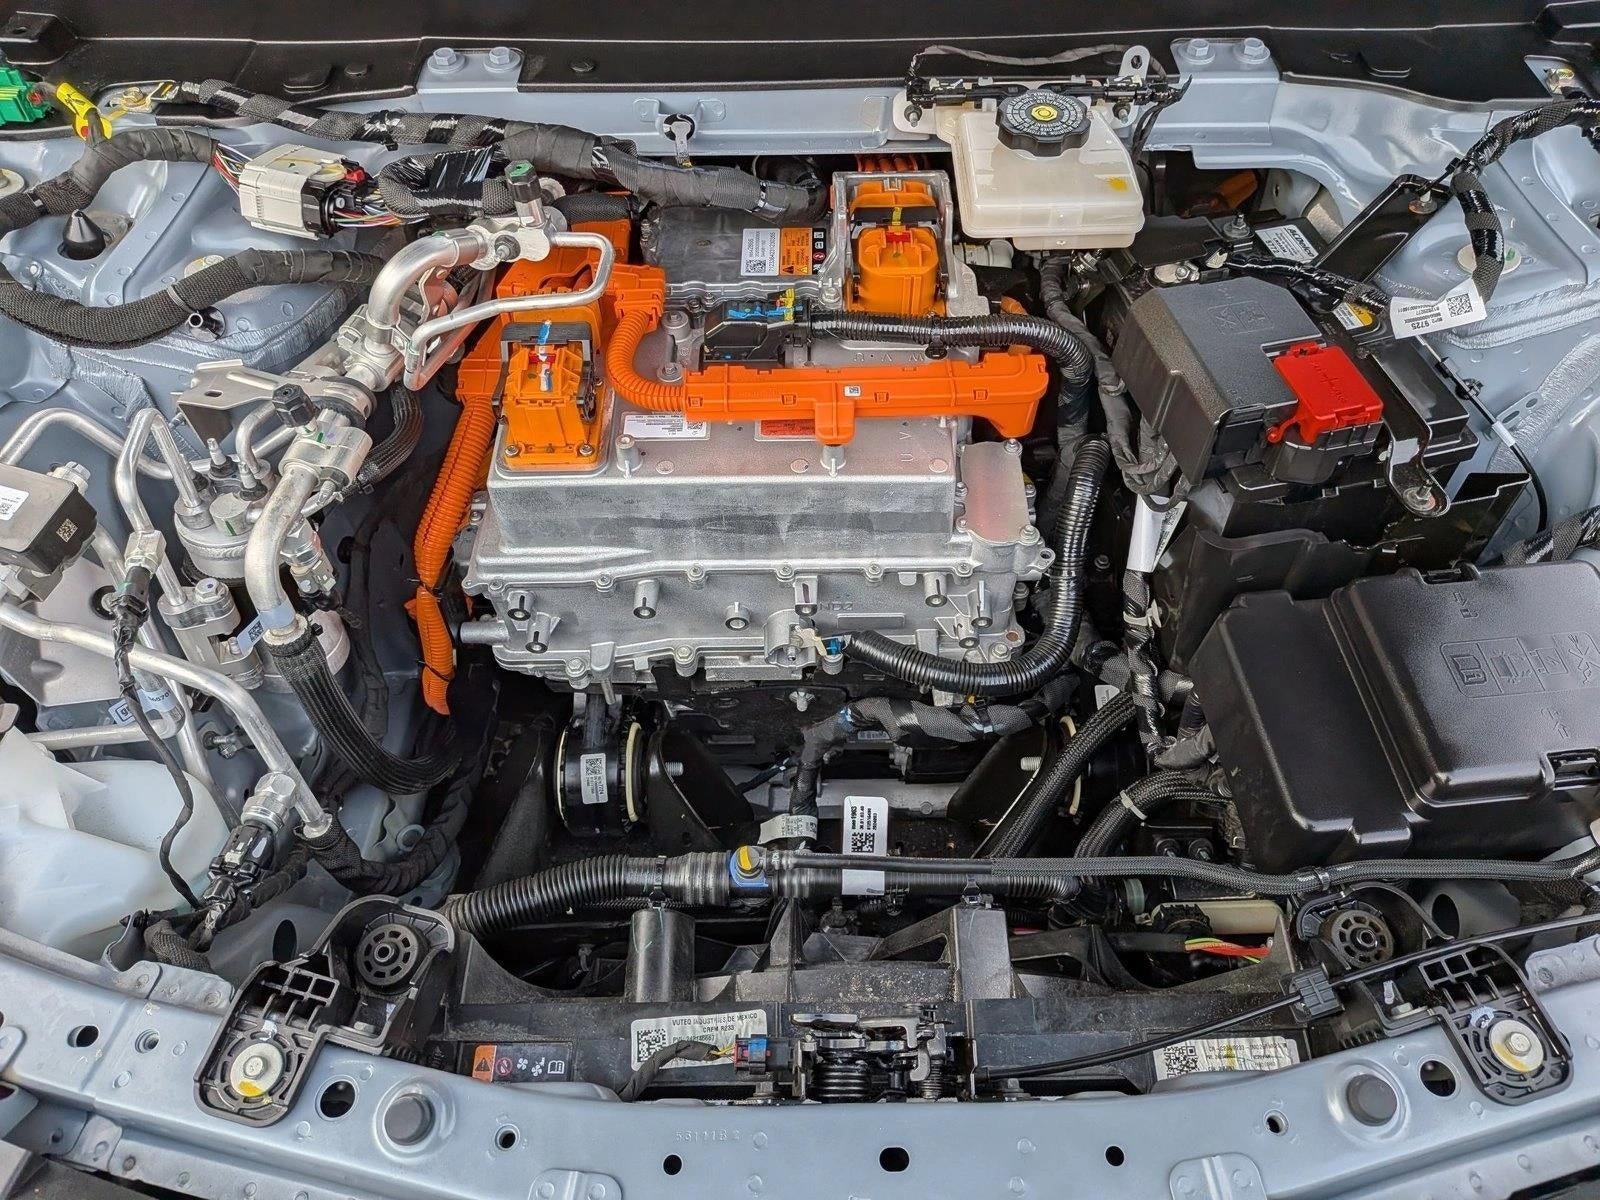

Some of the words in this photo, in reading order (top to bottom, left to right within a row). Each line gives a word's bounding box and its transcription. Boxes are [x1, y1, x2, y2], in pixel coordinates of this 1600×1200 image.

[1287, 228, 1315, 258] ACDelco
[1411, 320, 1430, 330] 9725
[692, 1016, 727, 1025] INDUSTRIES
[737, 1012, 758, 1021] MEXICO
